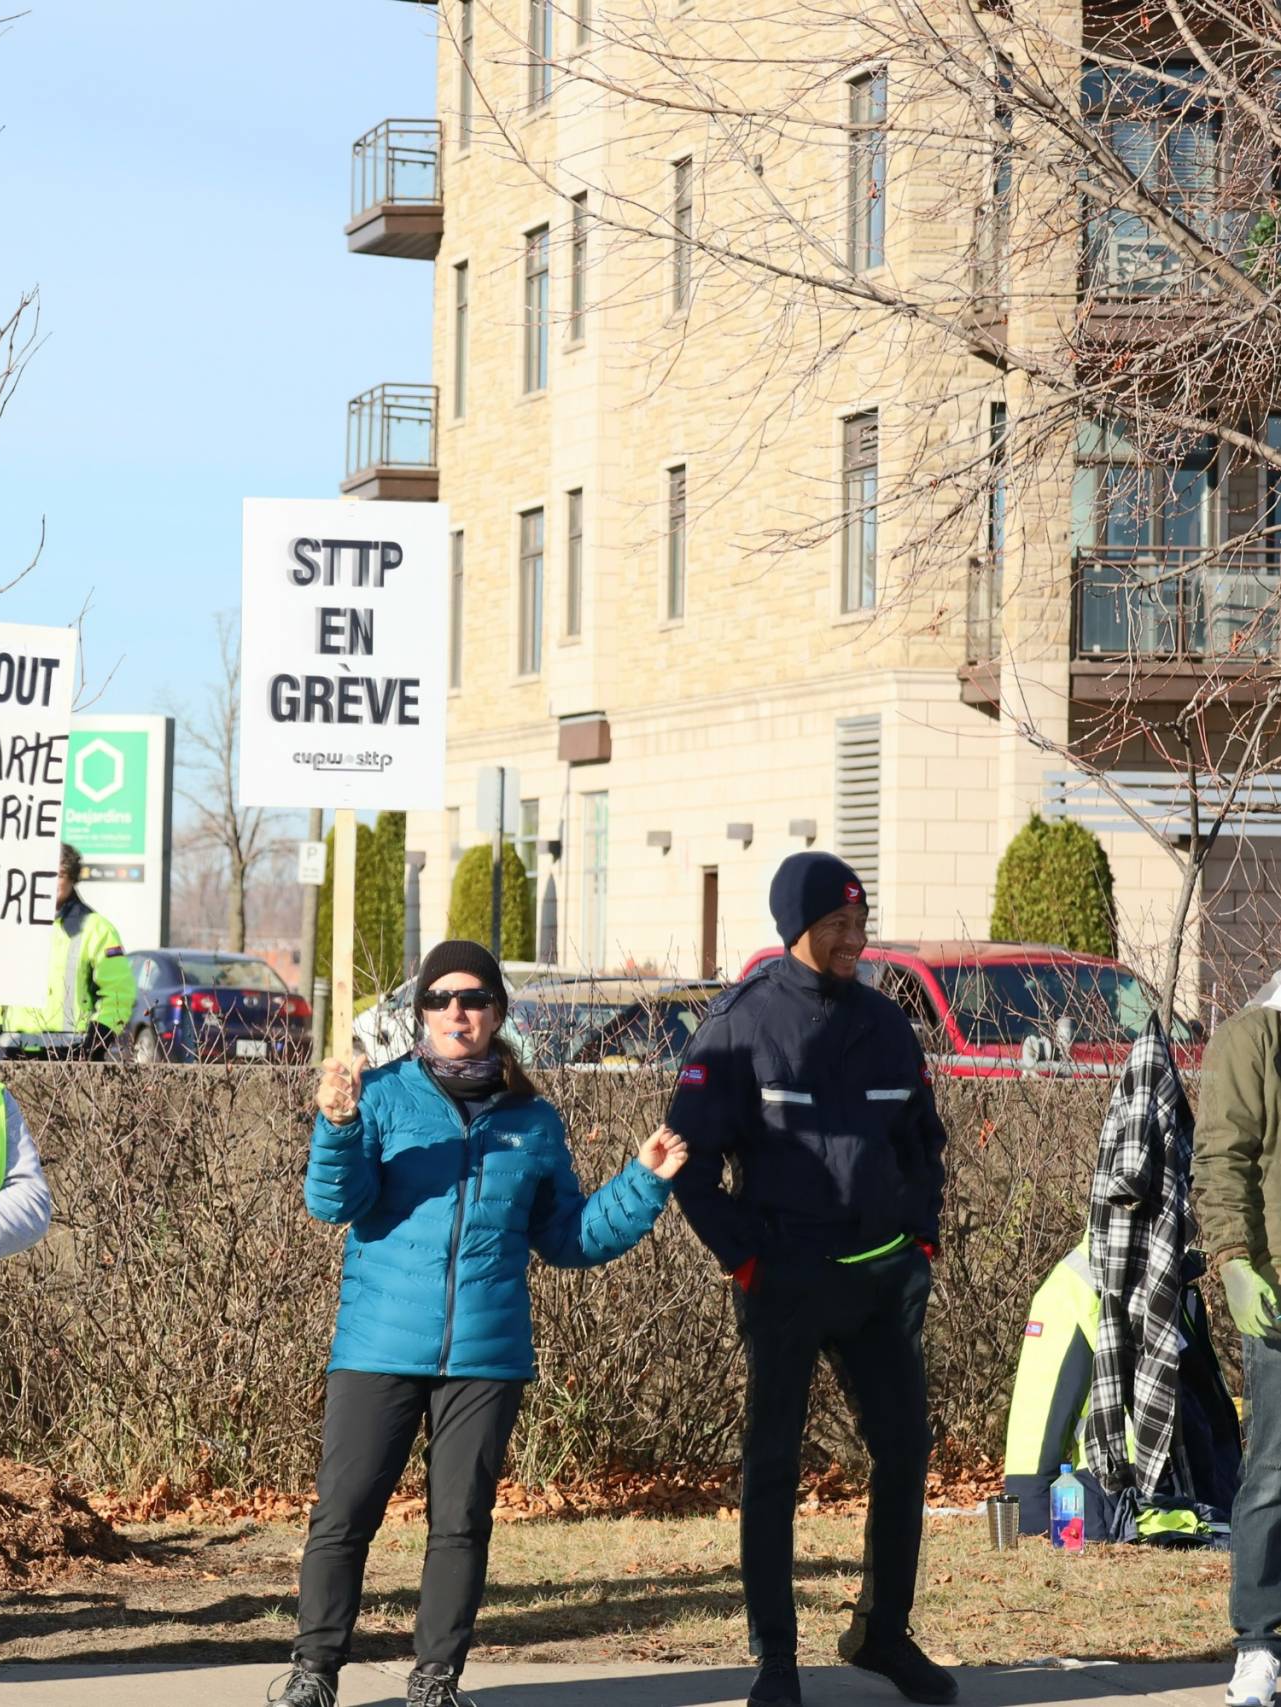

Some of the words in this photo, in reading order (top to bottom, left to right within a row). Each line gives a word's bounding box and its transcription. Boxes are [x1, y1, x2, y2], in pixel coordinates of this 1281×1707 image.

[287, 537, 403, 588] STTP
[315, 607, 374, 656] EN
[267, 663, 420, 726] GRÈVE
[293, 751, 344, 771] cupw
[356, 751, 393, 772] sttp
[66, 807, 132, 825] Desjardins
